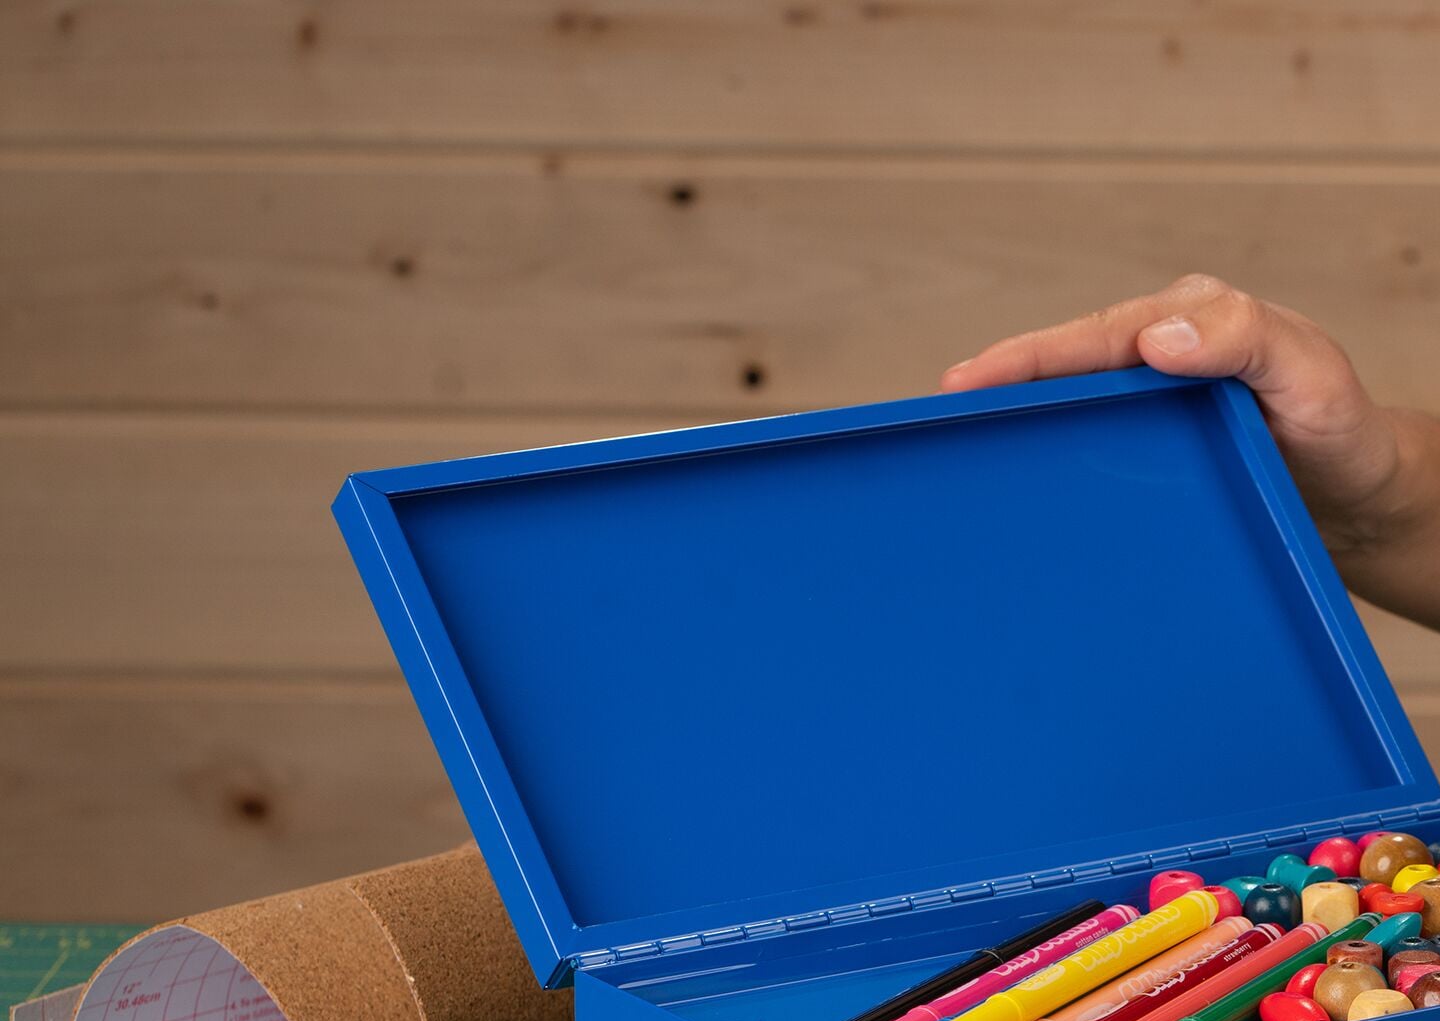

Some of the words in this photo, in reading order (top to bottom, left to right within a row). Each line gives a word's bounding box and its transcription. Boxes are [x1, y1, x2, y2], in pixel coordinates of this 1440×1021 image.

[1075, 934, 1093, 949] cotton
[1092, 926, 1110, 941] candy
[1223, 943, 1252, 962] strawberry
